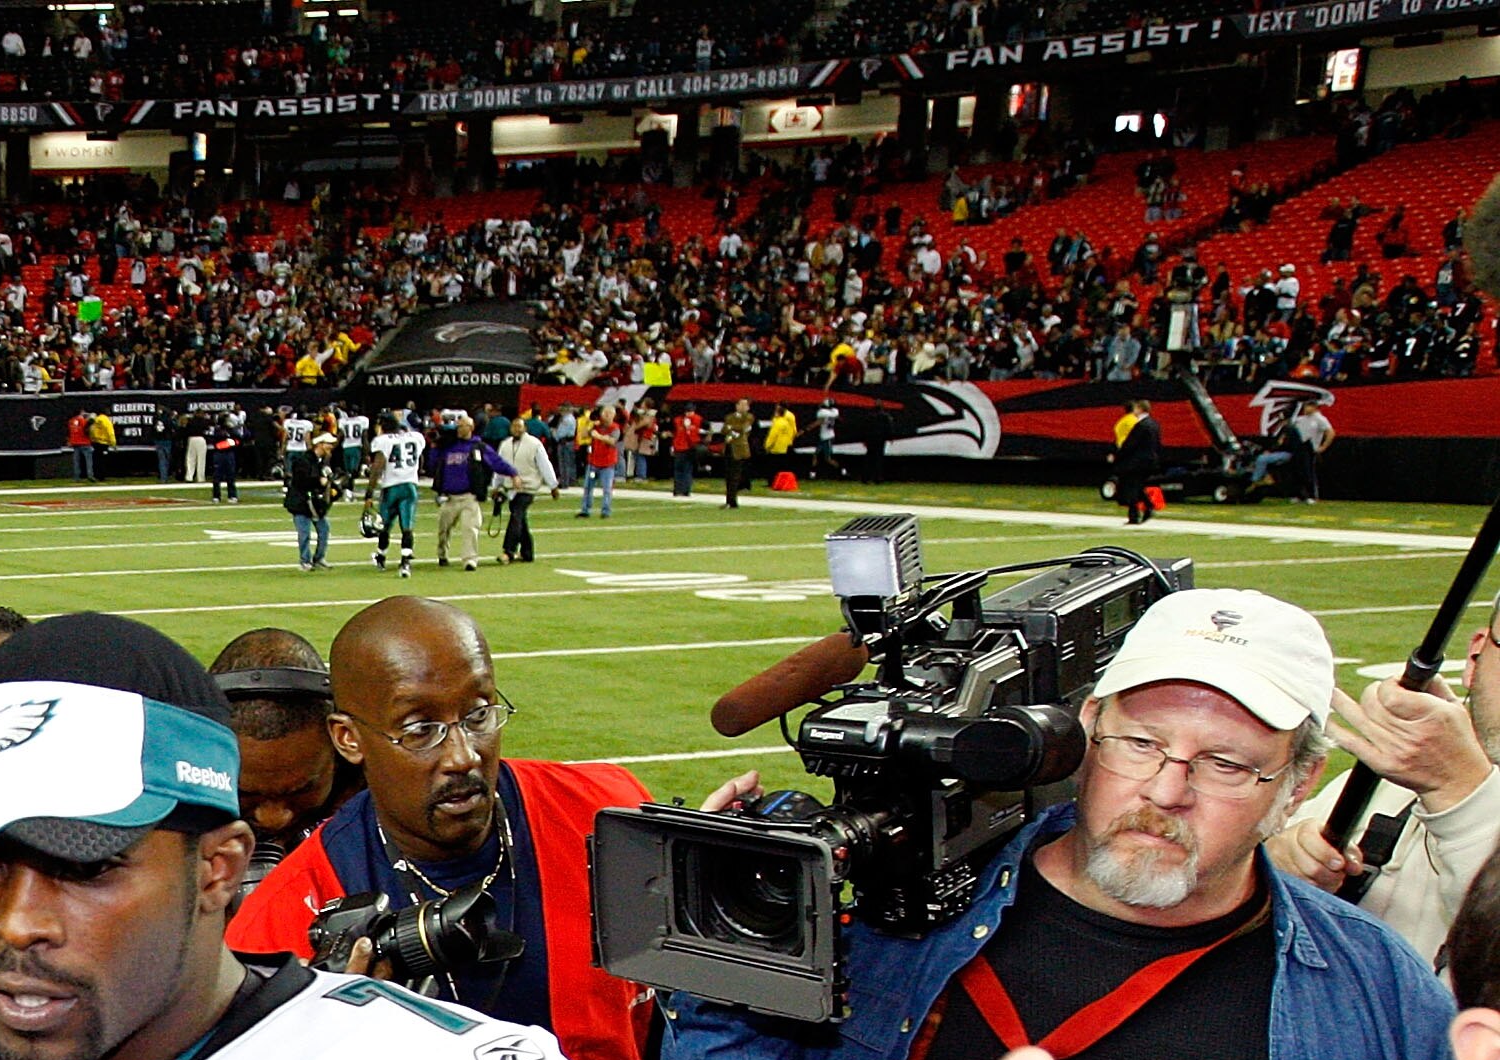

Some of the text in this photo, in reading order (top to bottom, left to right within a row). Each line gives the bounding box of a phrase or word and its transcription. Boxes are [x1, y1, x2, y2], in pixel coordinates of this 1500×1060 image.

[946, 44, 1023, 71] FAN
[1248, 11, 1298, 34] TEXT
[174, 100, 239, 119] FAN
[419, 93, 458, 111] TEXT
[536, 86, 552, 103] to
[559, 82, 606, 101] 78247
[612, 84, 630, 98] or
[636, 78, 677, 98] CALL
[682, 68, 800, 93] 404-223-8850
[55, 146, 116, 159] WOMEN
[1404, 337, 1417, 357] 7
[388, 442, 418, 468] 43
[175, 760, 233, 792] Reebok
[322, 977, 485, 1036] 7
